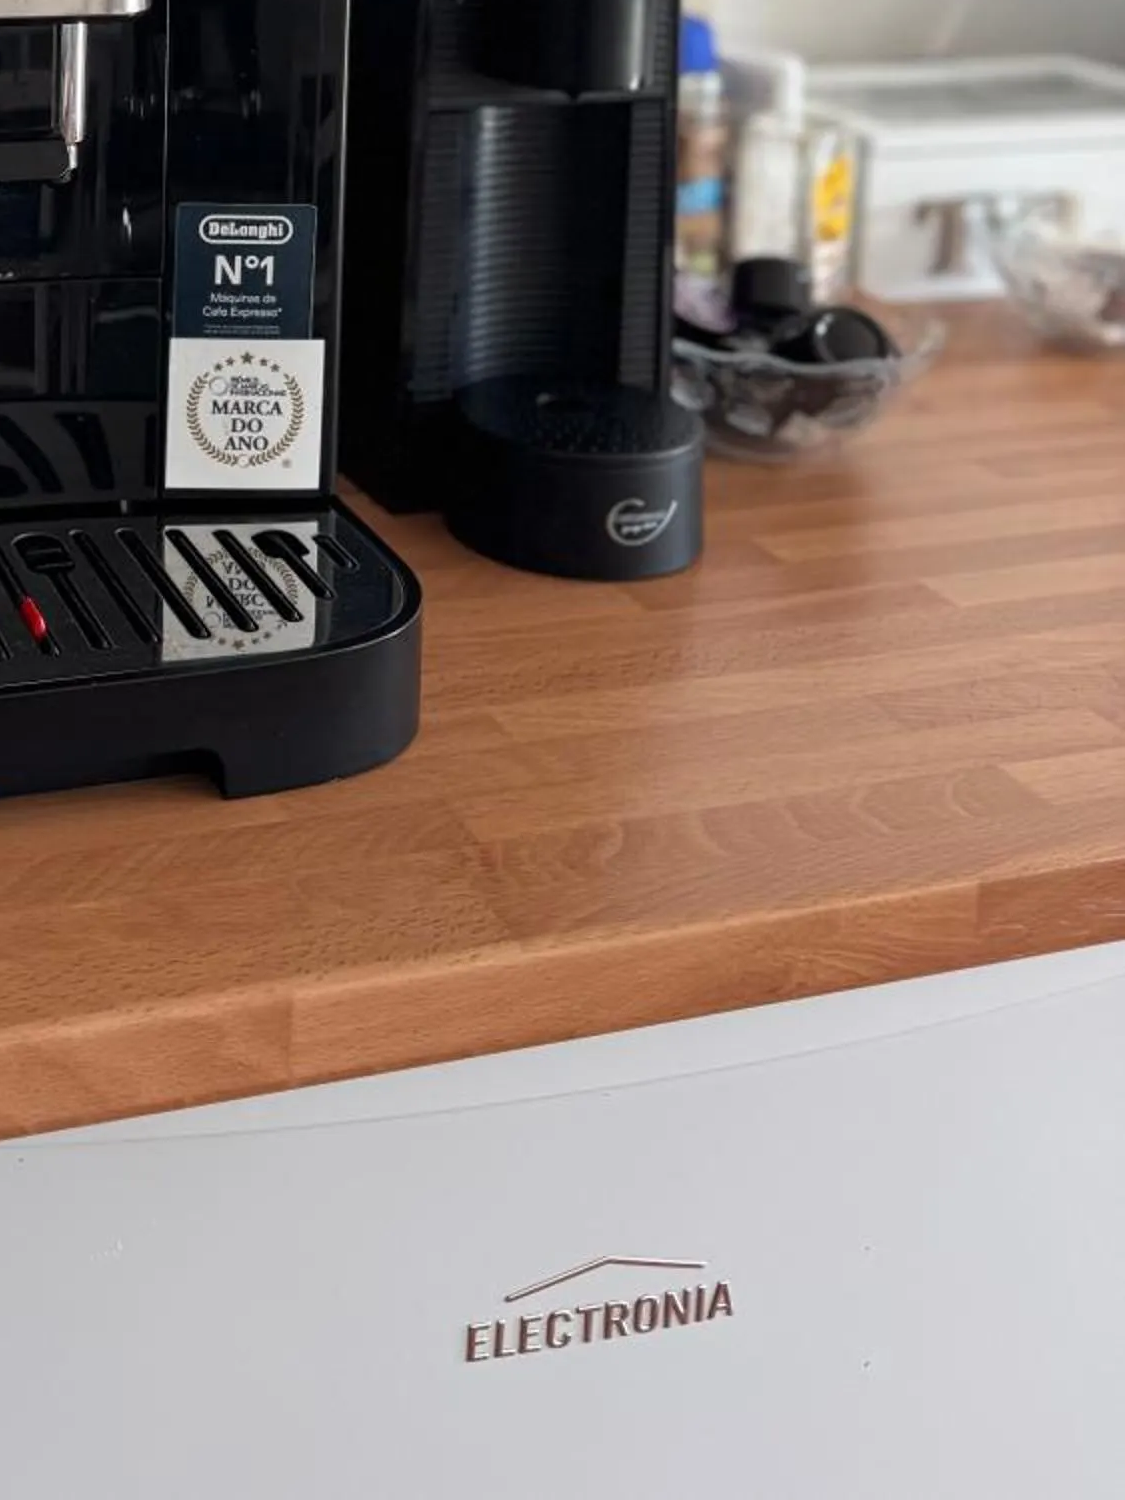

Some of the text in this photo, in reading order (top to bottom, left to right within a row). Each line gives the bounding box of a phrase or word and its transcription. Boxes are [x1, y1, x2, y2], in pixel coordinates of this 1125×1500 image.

[211, 400, 283, 416] MARCA
[231, 418, 263, 433] DO
[224, 436, 269, 451] ANO
[465, 1279, 735, 1363] ELECTRONIA
